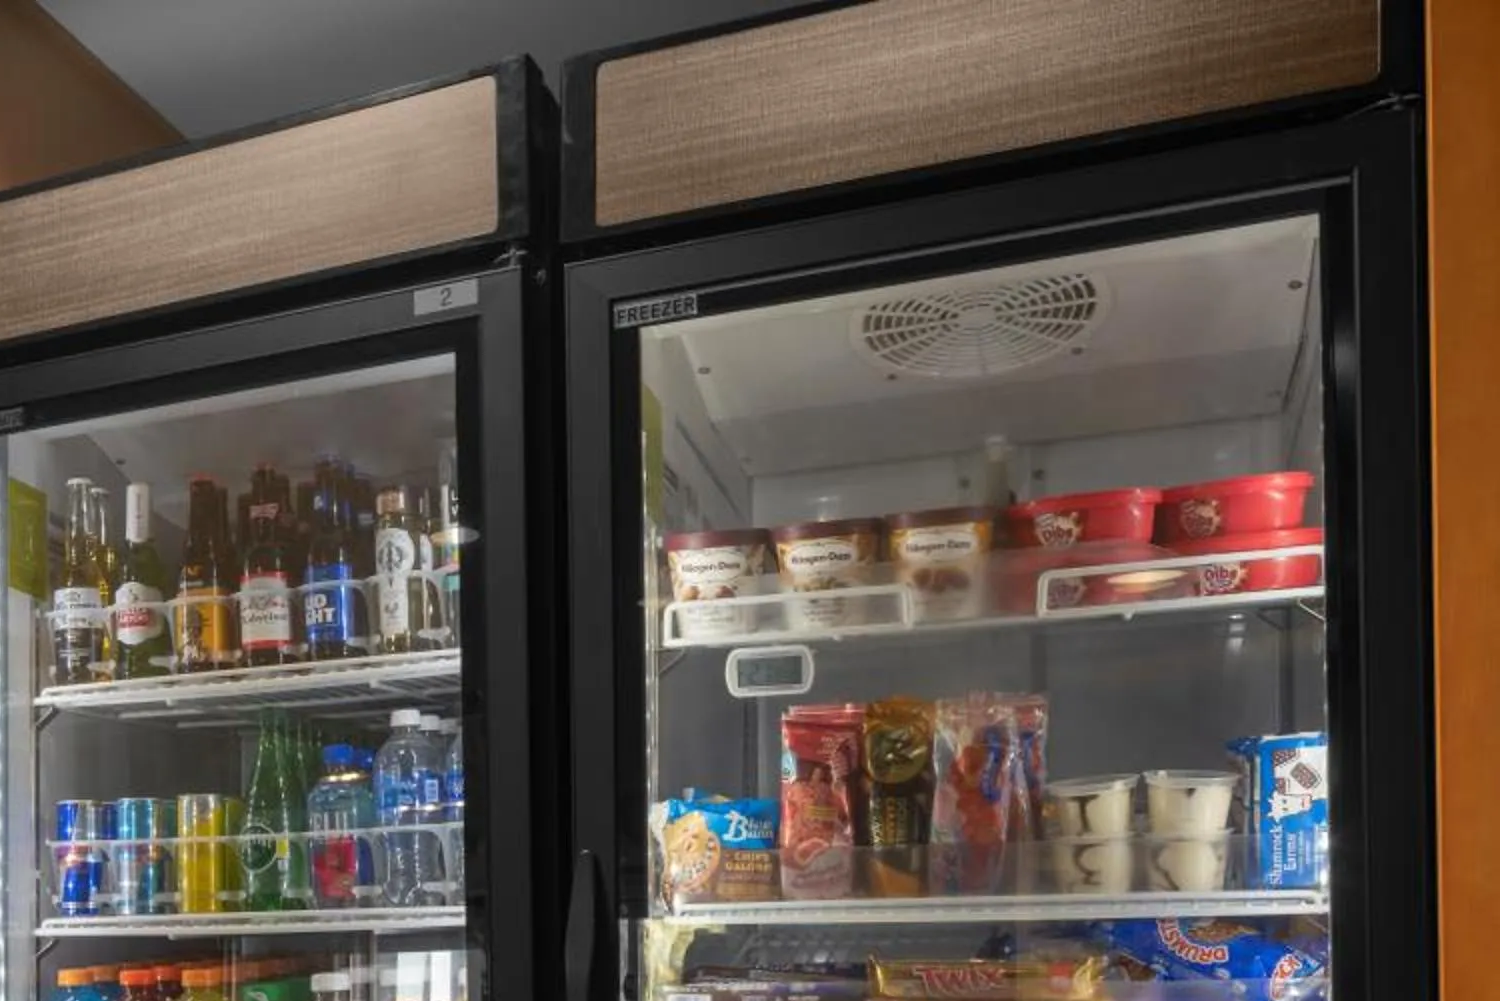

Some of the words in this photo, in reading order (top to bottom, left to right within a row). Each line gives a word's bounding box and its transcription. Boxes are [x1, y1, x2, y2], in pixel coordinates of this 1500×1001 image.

[439, 287, 452, 307] 2
[616, 297, 697, 323] FREEZER
[1268, 820, 1283, 886] Shamrock
[1284, 833, 1298, 872] Farms
